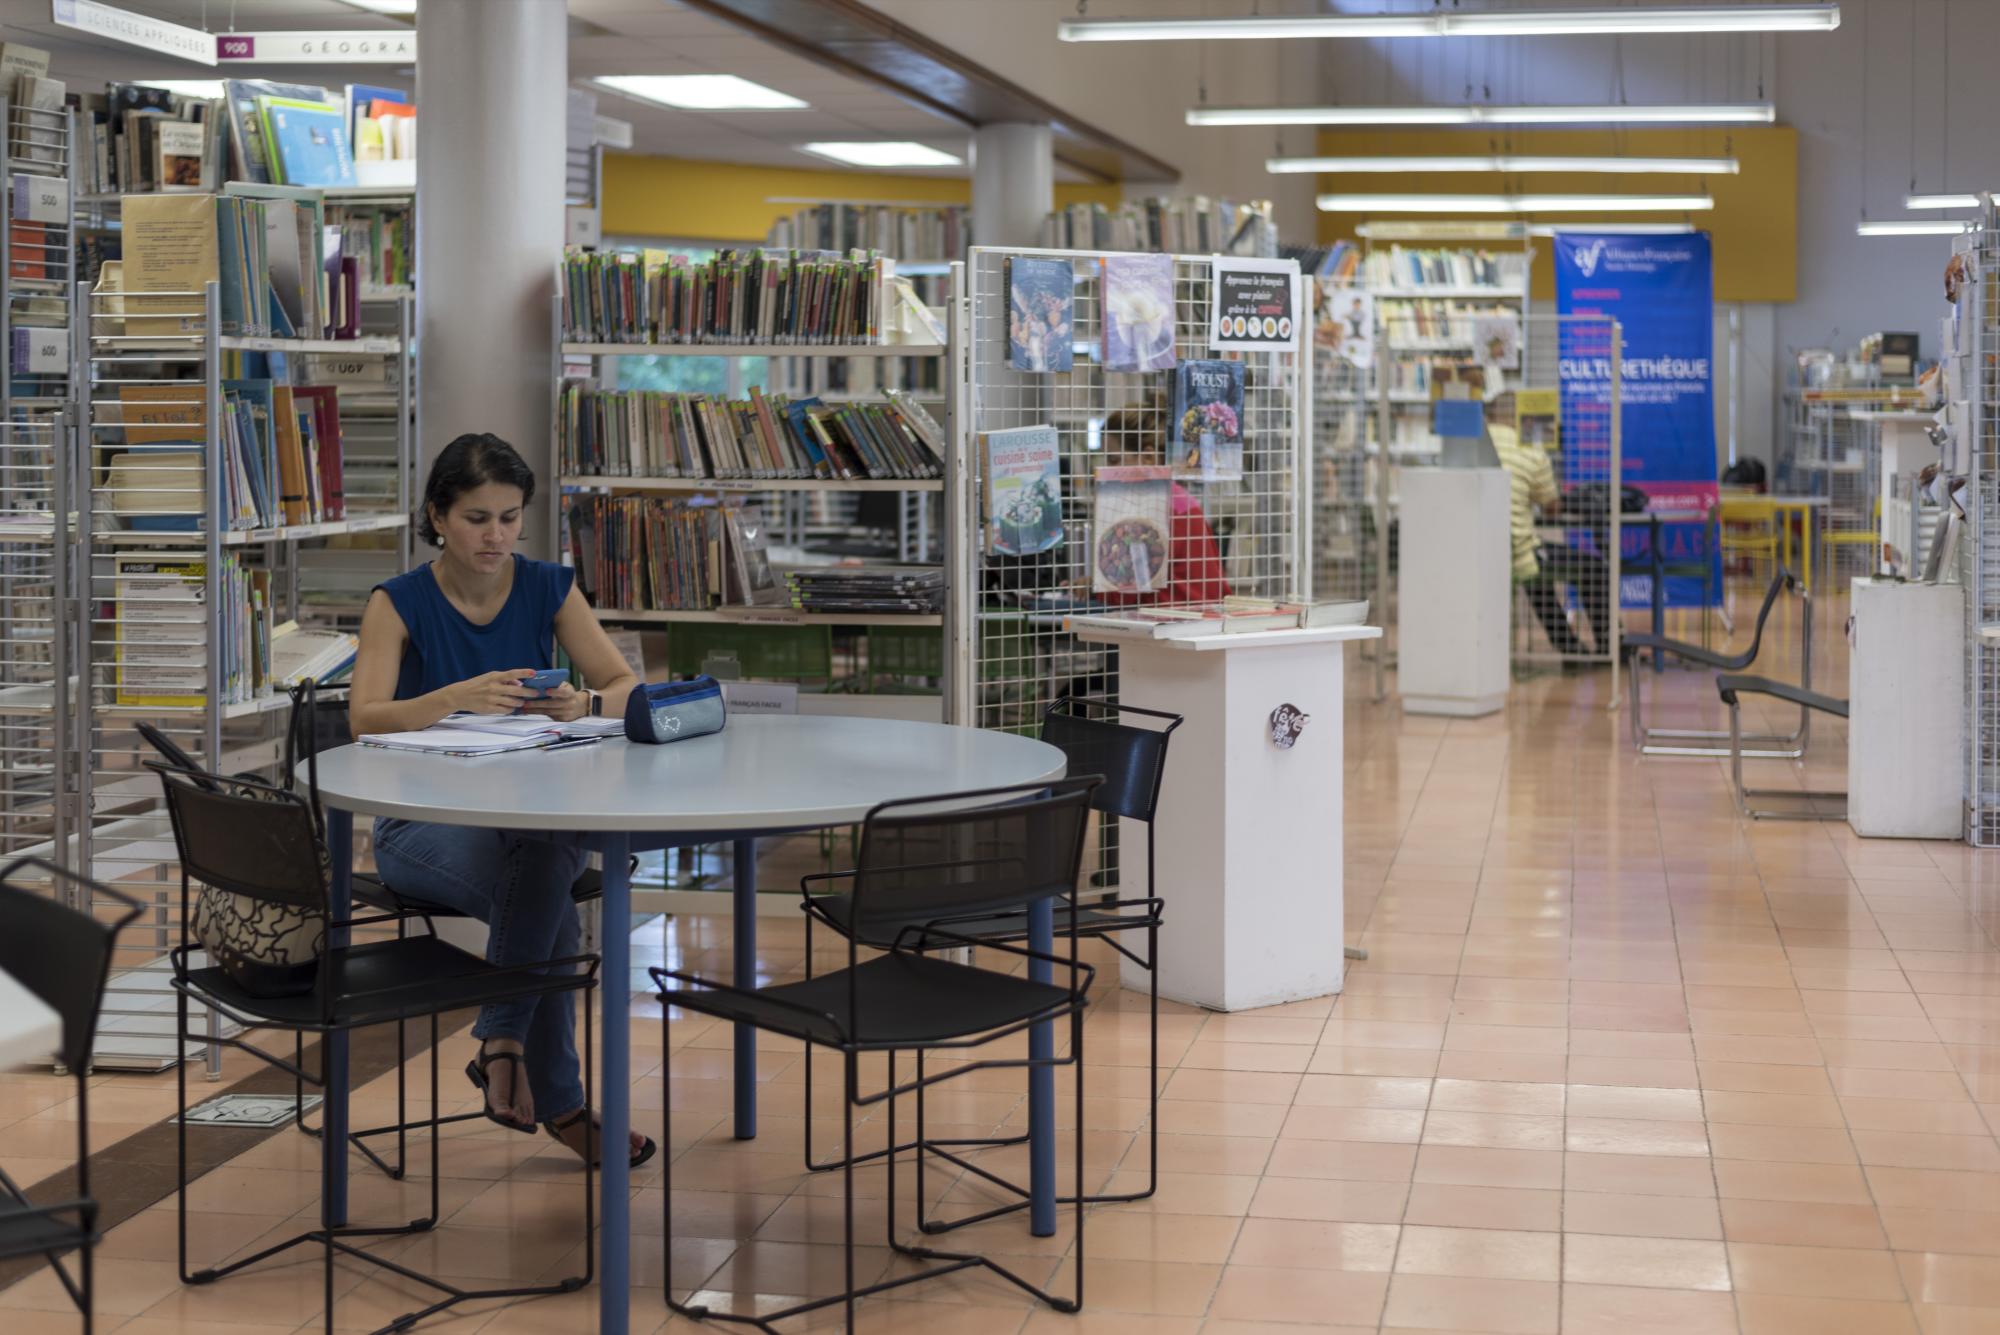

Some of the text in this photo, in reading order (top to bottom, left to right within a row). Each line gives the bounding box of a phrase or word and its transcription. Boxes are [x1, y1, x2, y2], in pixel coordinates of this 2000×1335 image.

[87, 10, 139, 36] SCIENCES
[224, 41, 248, 55] 900
[41, 193, 57, 207] 500
[1259, 275, 1285, 289] français
[41, 344, 57, 358] 600
[1191, 372, 1230, 388] PROUST
[992, 431, 1053, 449] LAROUSSE
[993, 447, 1053, 467] cuisine saine
[730, 700, 782, 709] FRANÇAIS FACILE
